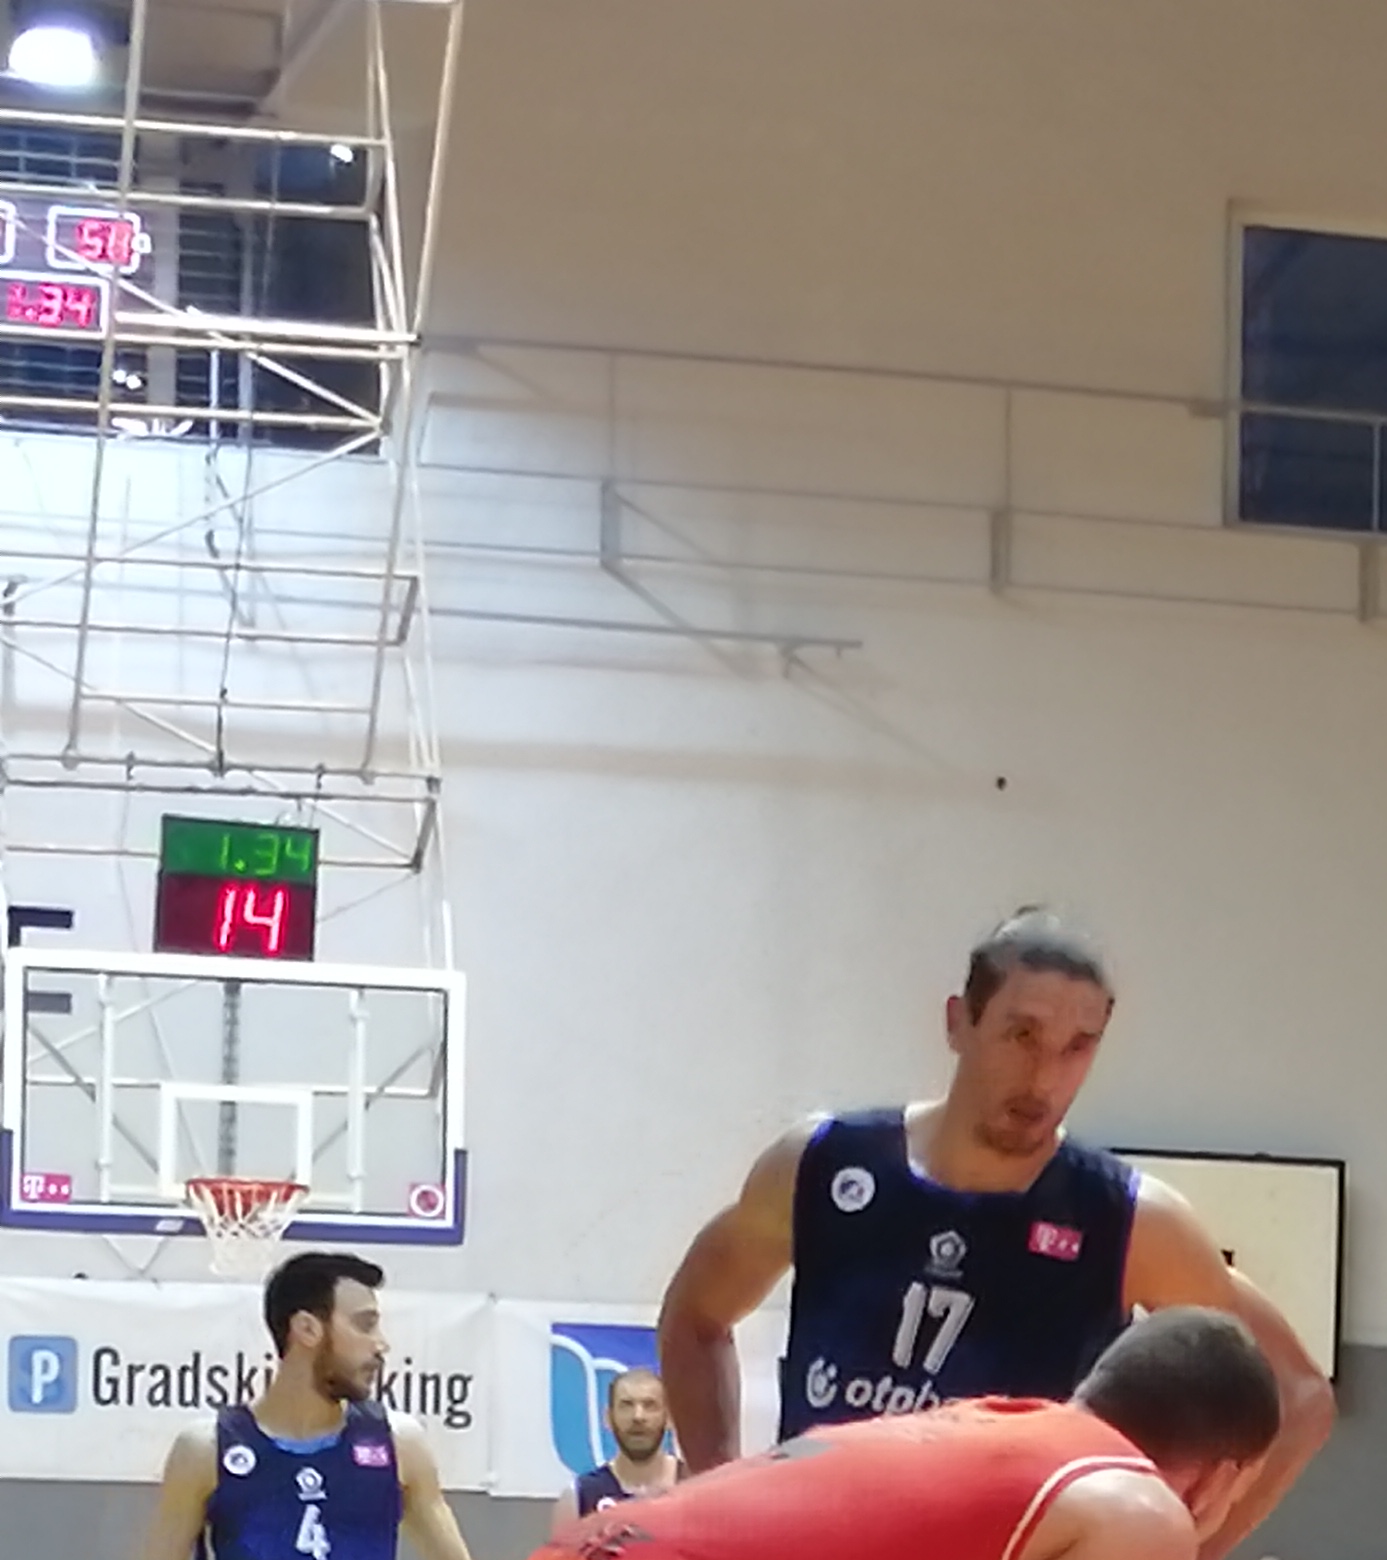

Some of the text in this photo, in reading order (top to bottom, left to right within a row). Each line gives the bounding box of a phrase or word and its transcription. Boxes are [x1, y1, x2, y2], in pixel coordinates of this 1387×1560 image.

[219, 833, 312, 876] 1.34
[216, 884, 288, 953] 14
[892, 1280, 976, 1376] 17
[31, 1346, 474, 1430] P Gradski king
